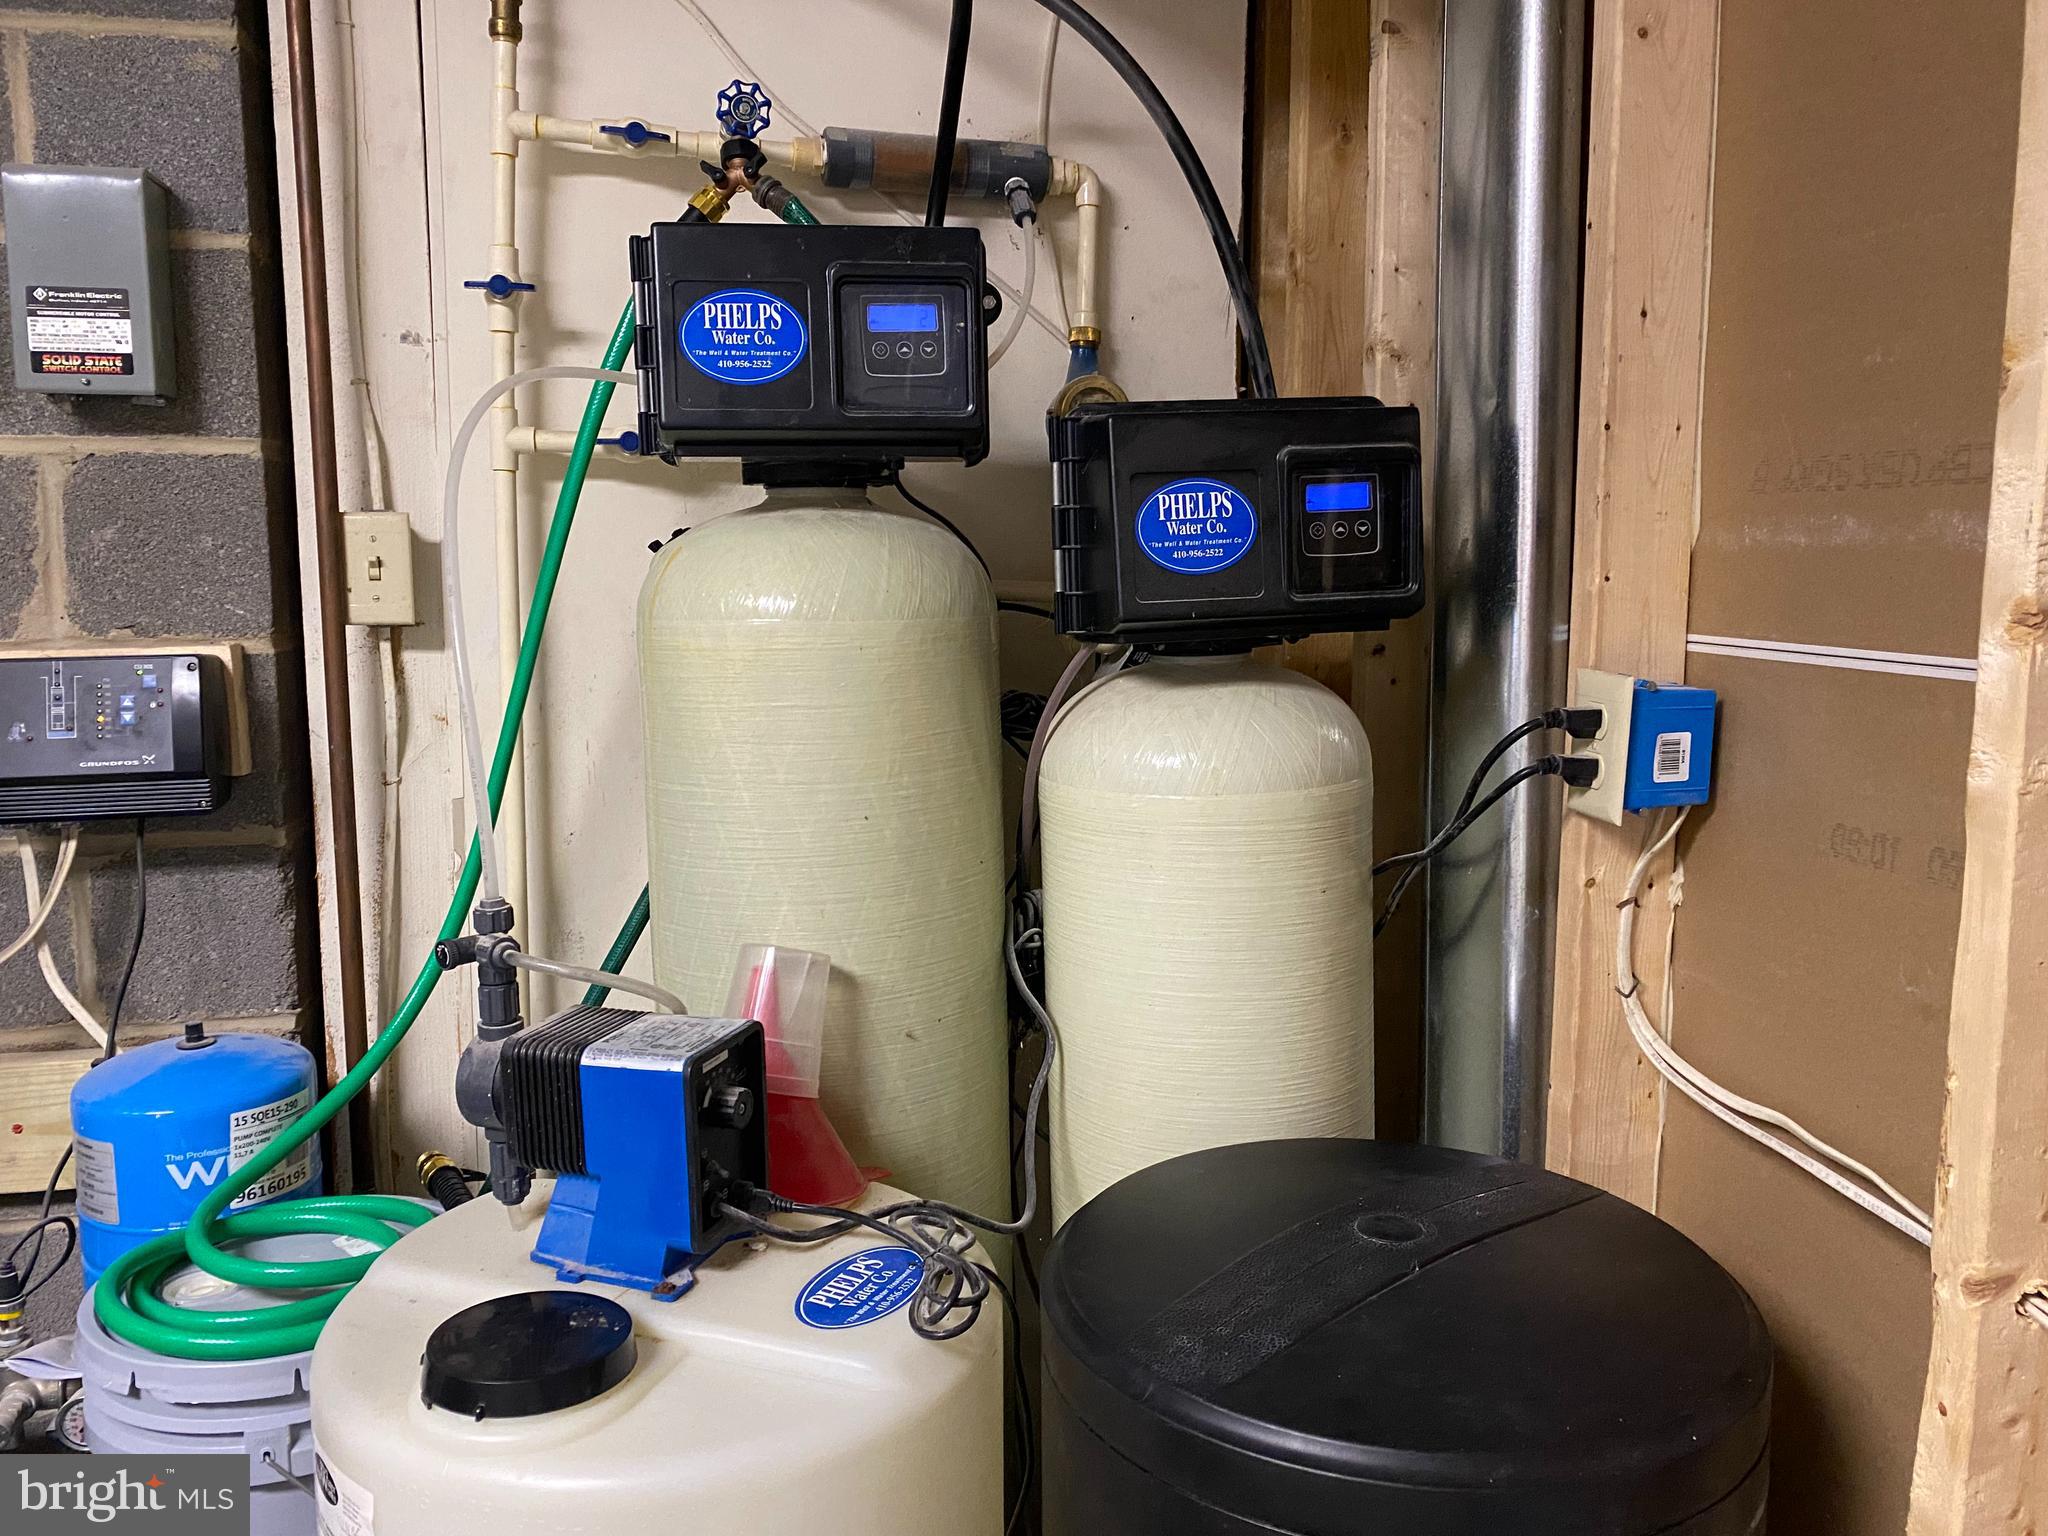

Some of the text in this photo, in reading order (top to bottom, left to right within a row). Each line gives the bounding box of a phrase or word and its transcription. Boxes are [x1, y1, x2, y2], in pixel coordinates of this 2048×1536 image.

[48, 291, 85, 299] Franklin
[703, 303, 783, 330] PHELPS
[711, 330, 776, 345] Water Co.
[42, 354, 123, 367] SOLID STATE
[717, 360, 772, 368] 410-956-2522
[42, 365, 123, 374] SWITCH CONTROL
[1158, 490, 1233, 520] PHELPS
[1166, 519, 1227, 536] Water Co.
[1203, 537, 1233, 545] Treatment
[1172, 548, 1224, 559] 410-956-2522
[234, 1115, 247, 1127] 15
[233, 1133, 253, 1142] PUMP
[165, 1153, 184, 1162] The
[235, 1166, 306, 1204] 96160195
[807, 1256, 884, 1309] PHELPS
[838, 1269, 897, 1307] Water Co.
[874, 1277, 918, 1312] 410-956-2522
